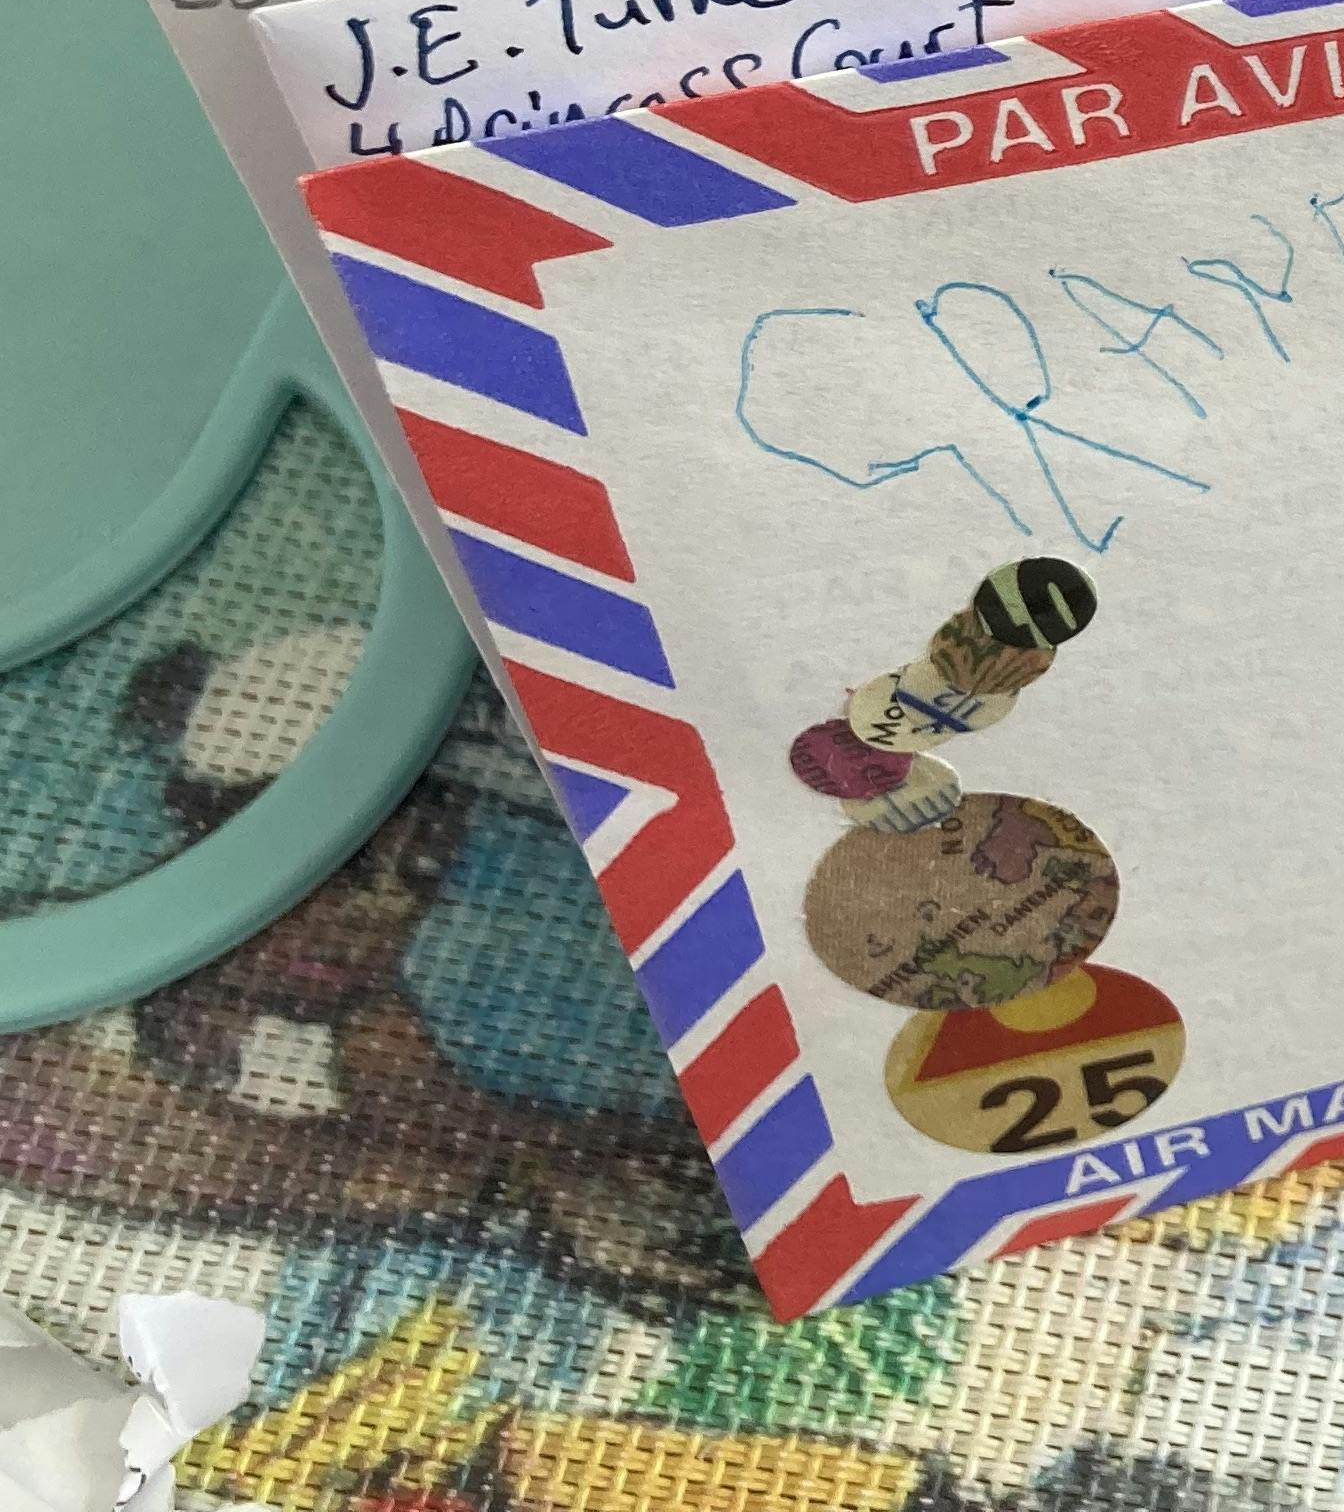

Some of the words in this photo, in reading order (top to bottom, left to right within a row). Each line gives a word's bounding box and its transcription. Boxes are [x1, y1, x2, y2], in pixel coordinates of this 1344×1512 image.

[907, 79, 1131, 178] PAR
[980, 1048, 1170, 1153] 25
[1065, 1126, 1210, 1197] AIR
